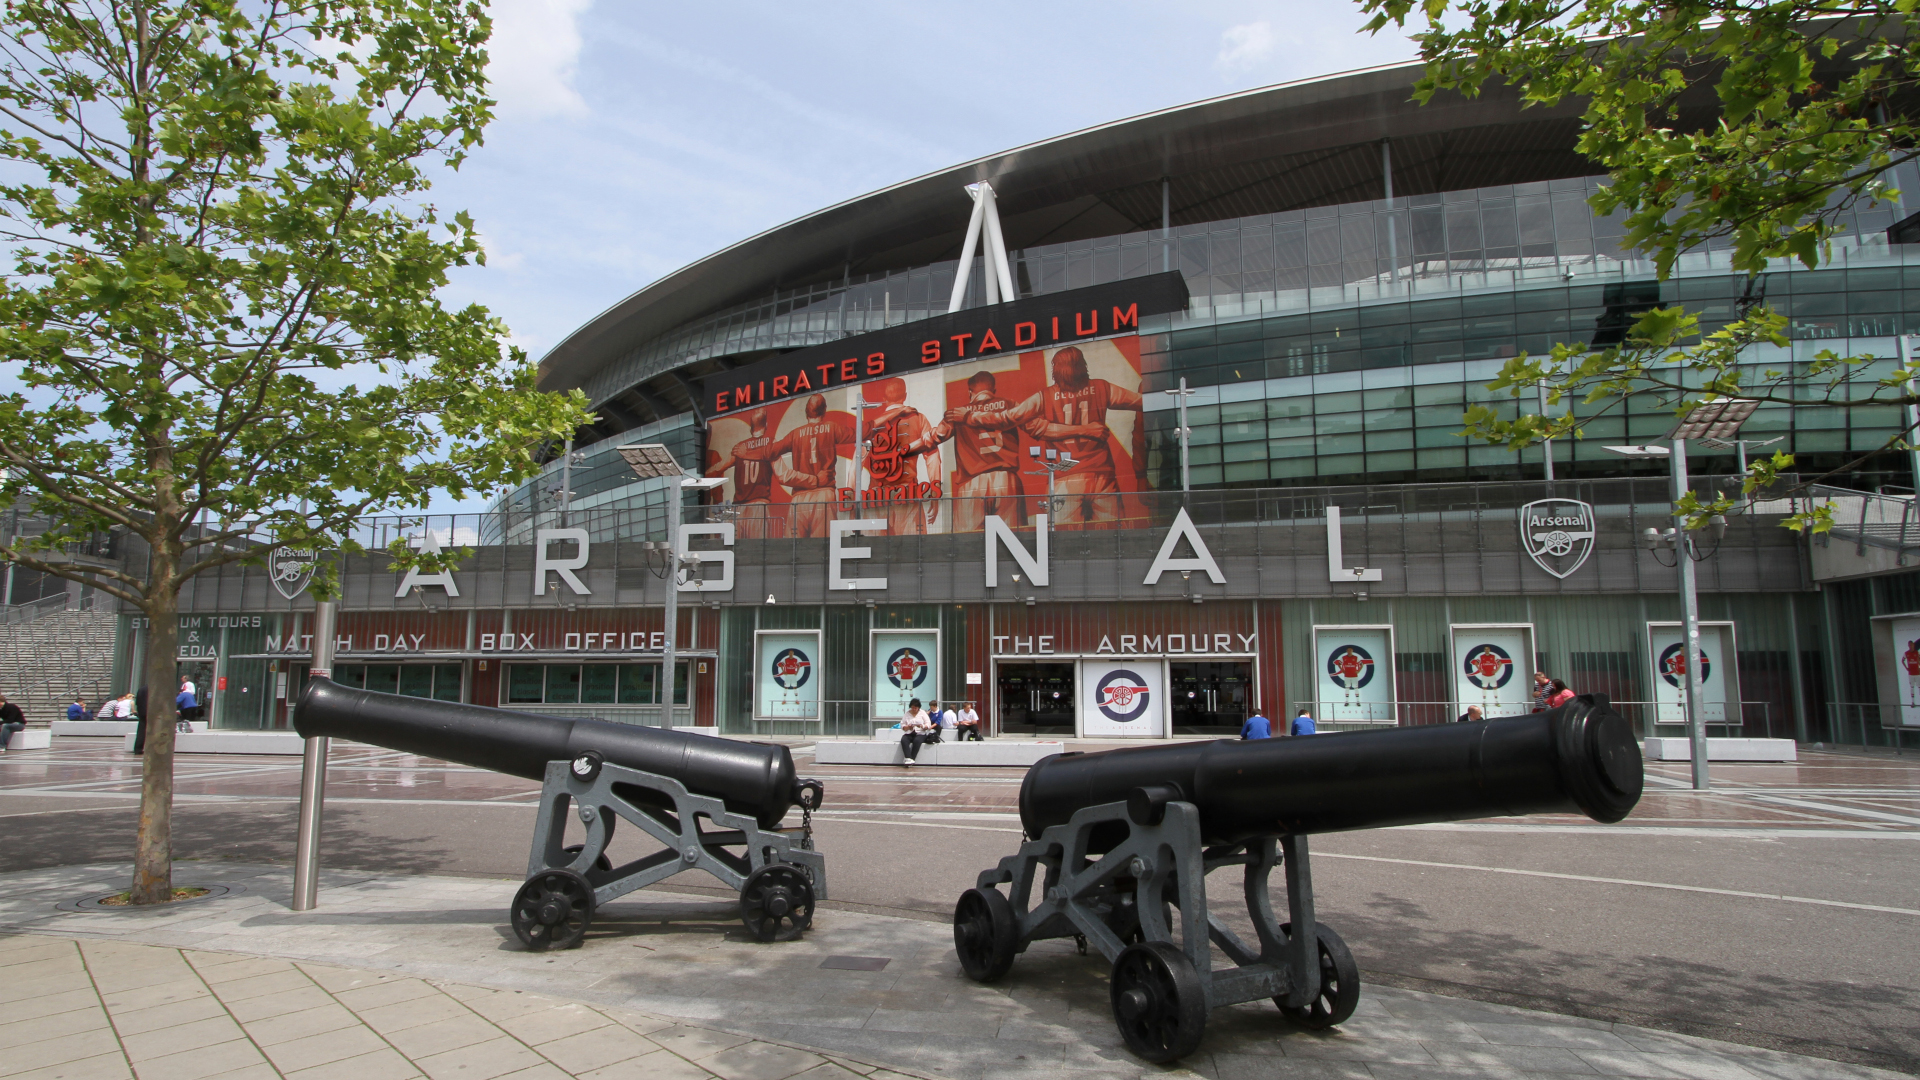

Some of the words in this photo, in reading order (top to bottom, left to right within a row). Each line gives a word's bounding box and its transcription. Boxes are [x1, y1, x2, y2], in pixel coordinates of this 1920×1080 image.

[716, 352, 884, 412] EMIRATES
[921, 302, 1138, 364] STADIUM
[1054, 386, 1095, 400] GEORGE
[799, 424, 830, 438] WILSON
[838, 480, 943, 512] Emirates
[1530, 514, 1585, 526] Arsenal
[395, 506, 1382, 597] ARSENAL
[131, 616, 201, 629] STUM
[208, 616, 262, 628] TOURS
[188, 631, 200, 642] &
[266, 634, 353, 651] MATH
[375, 633, 426, 651] DAY
[481, 633, 535, 650] BOX
[564, 632, 665, 650] OFFICE
[993, 635, 1054, 654] THE
[1096, 633, 1256, 654] ARMOURY
[177, 645, 217, 657] EDIA
